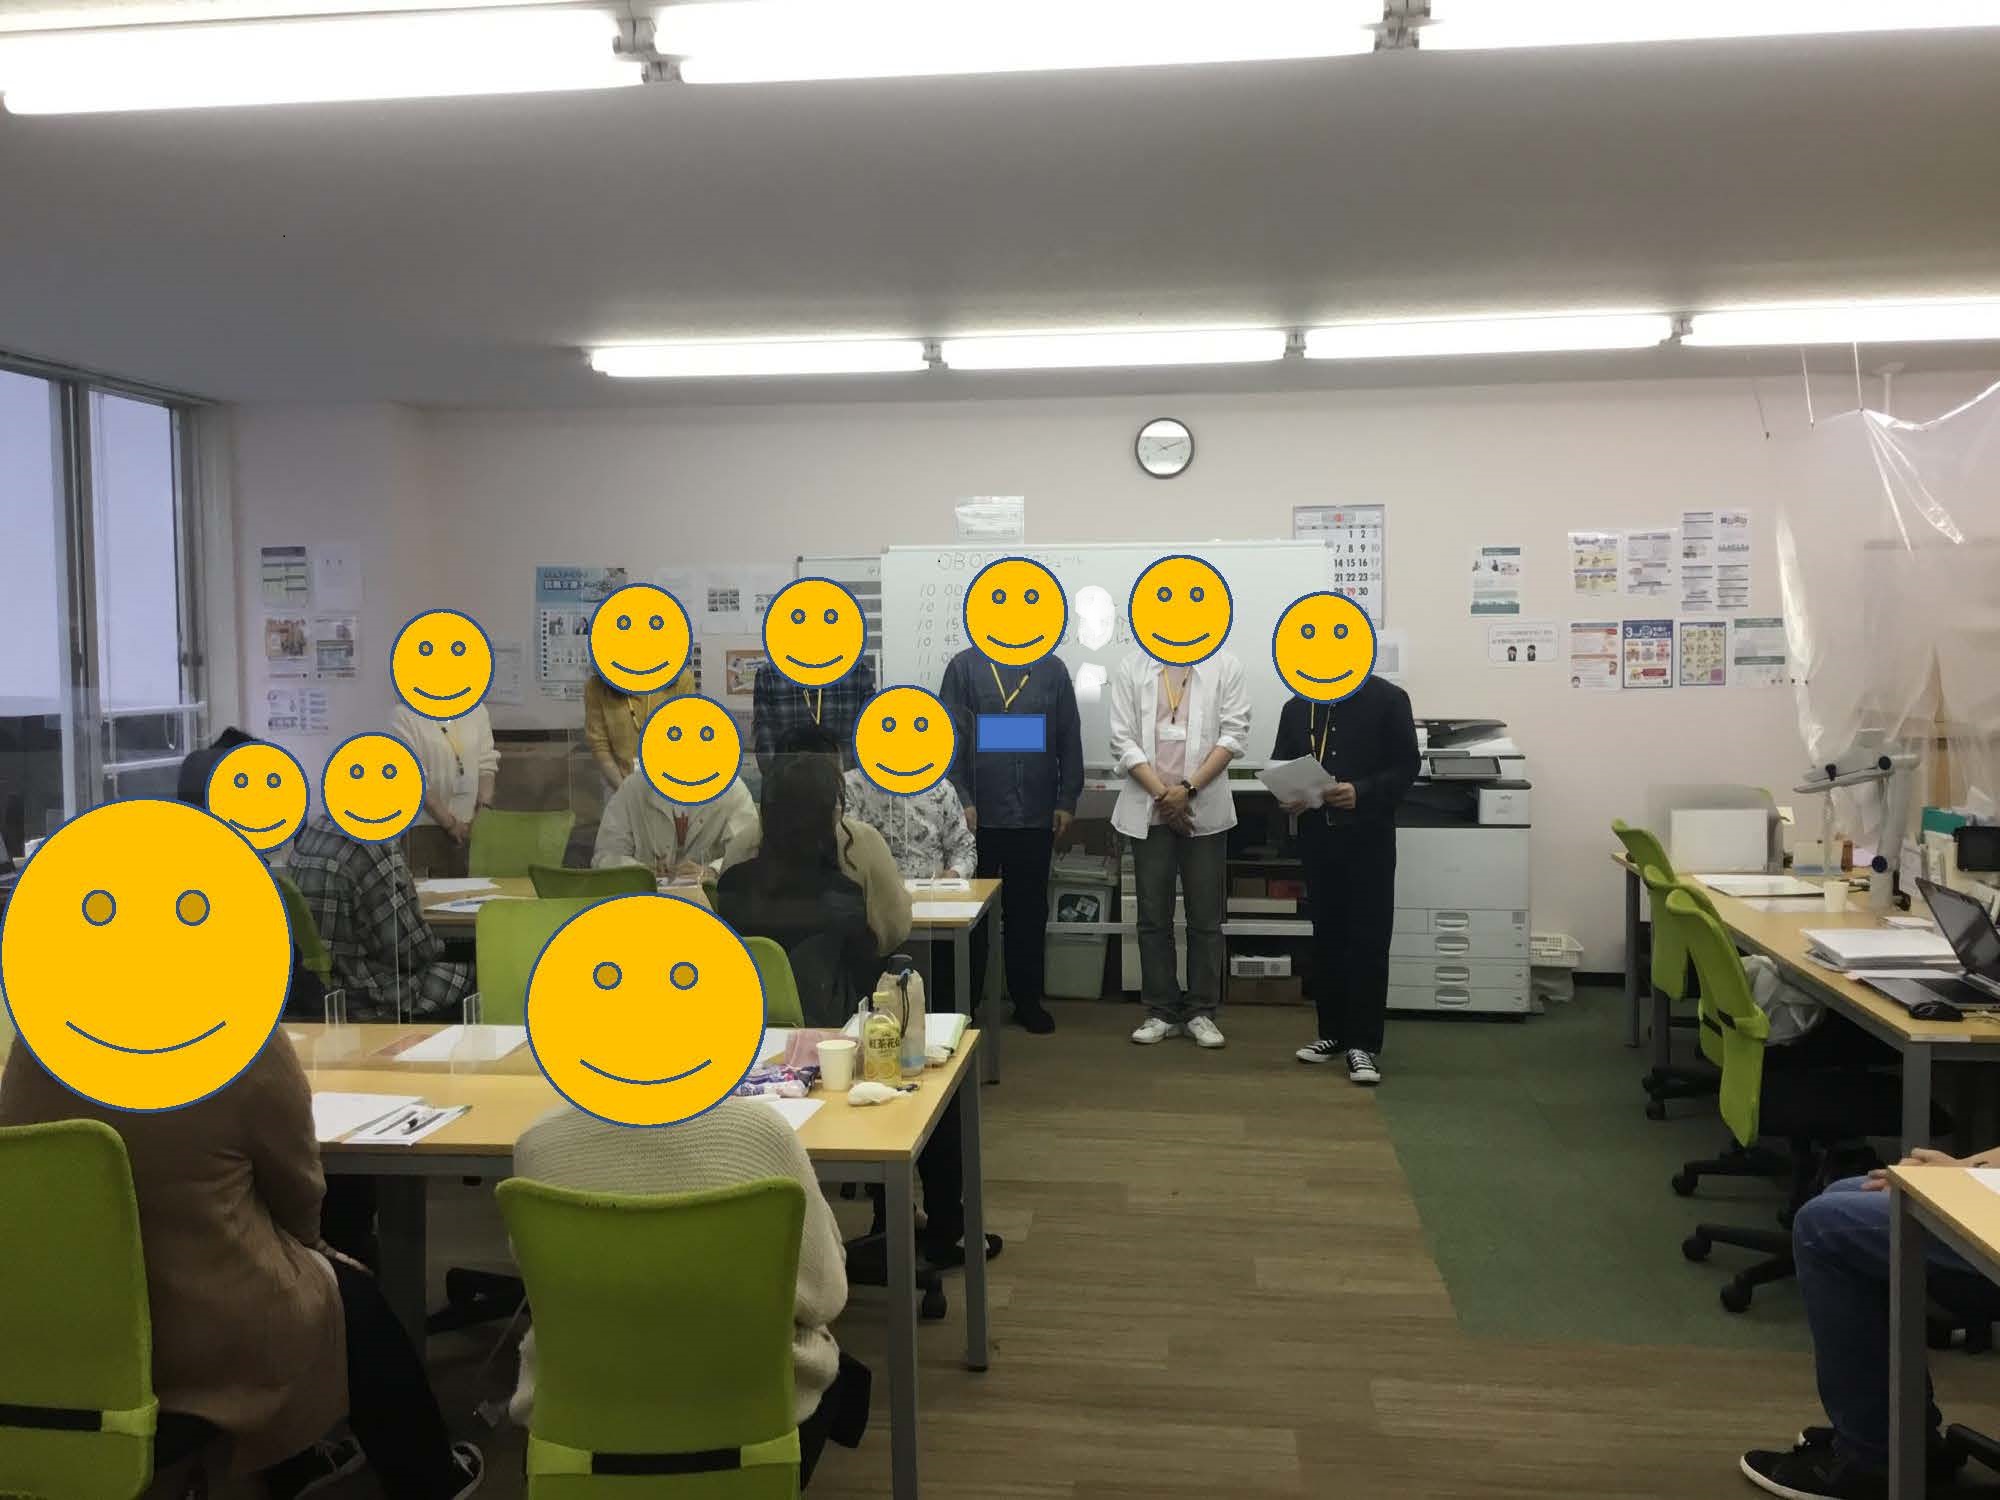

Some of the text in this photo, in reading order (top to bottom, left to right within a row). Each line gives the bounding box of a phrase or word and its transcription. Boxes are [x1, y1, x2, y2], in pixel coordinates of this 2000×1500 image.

[1348, 544, 1353, 553] 8
[1360, 544, 1366, 553] 9
[1334, 559, 1343, 568] 14
[1346, 559, 1355, 567] 15
[1358, 558, 1368, 567] 16
[1334, 573, 1343, 582] 21
[1346, 573, 1355, 582] 22
[1358, 573, 1368, 581] 23
[1358, 587, 1369, 596] 30
